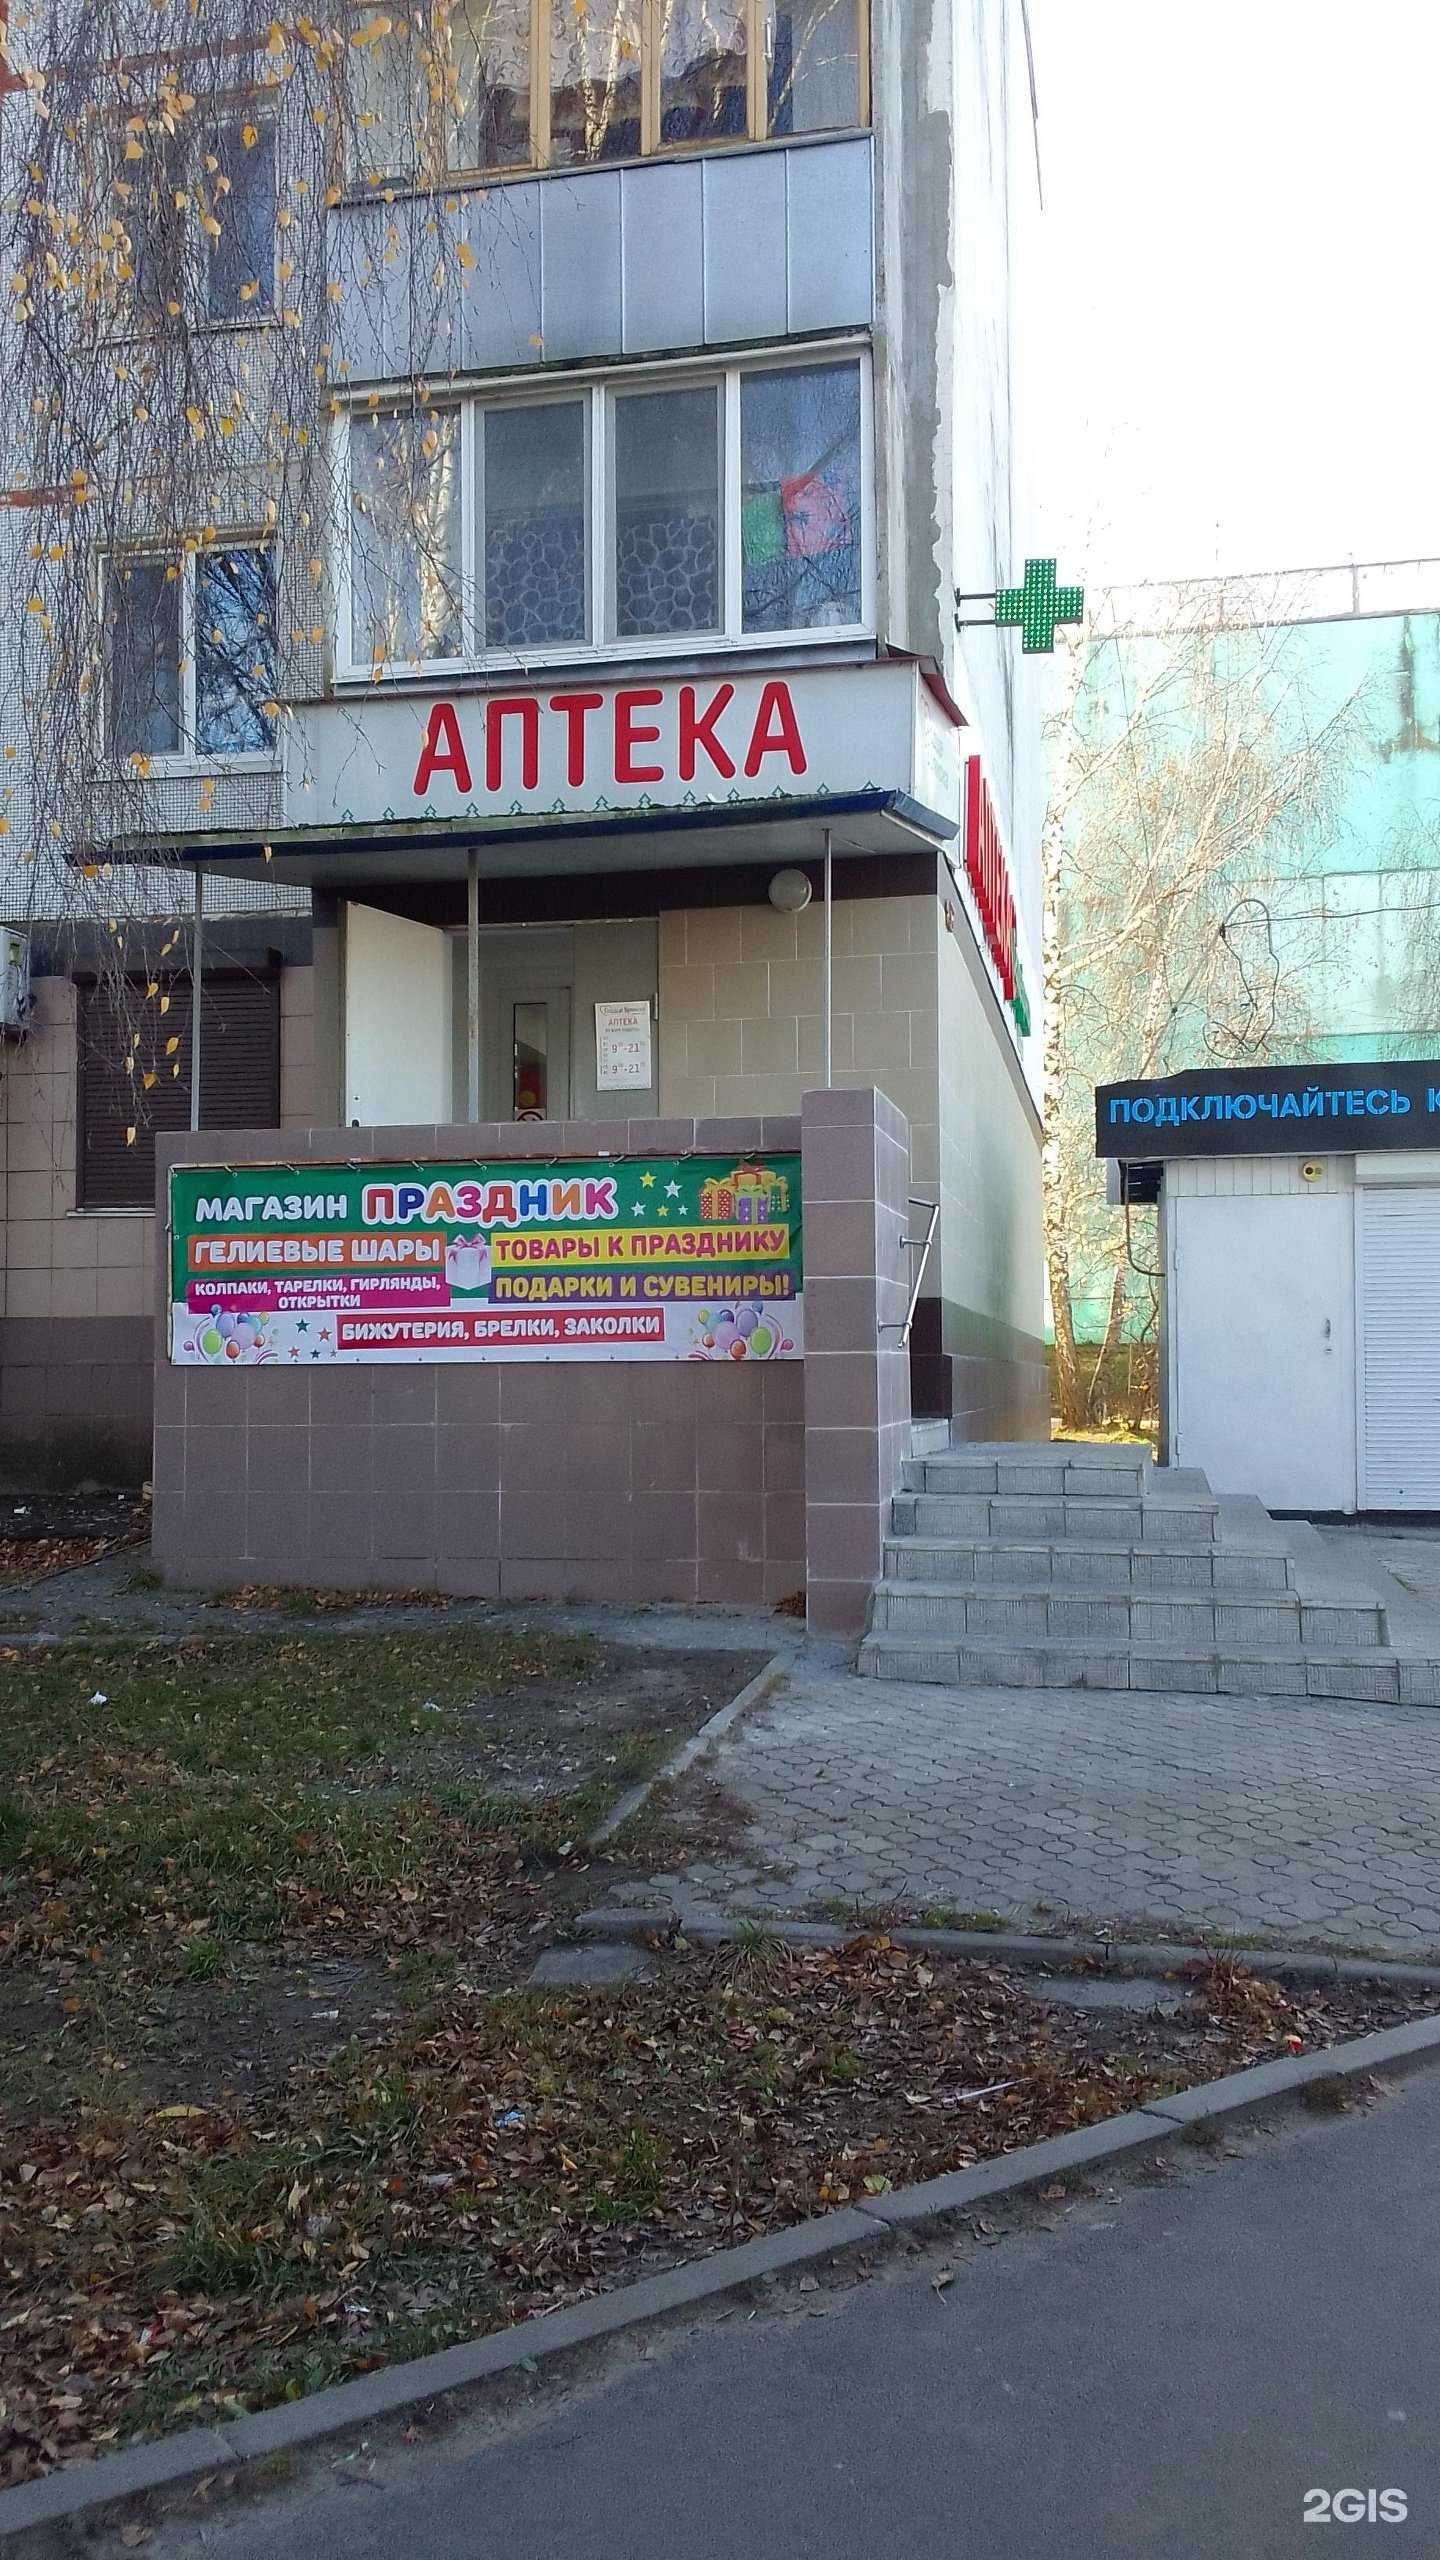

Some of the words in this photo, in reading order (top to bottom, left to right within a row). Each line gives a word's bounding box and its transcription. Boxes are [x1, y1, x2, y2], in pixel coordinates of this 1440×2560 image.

[413, 681, 808, 796] АПТЕКА
[1109, 1086, 1411, 1127] ПОДКЛЮЧАЙТЕСЬ
[195, 1194, 348, 1223] МАГАЗИН
[361, 1178, 618, 1229] ПРАЗДНИК
[194, 1239, 345, 1264] ГЕЛИЕВЫЕ
[351, 1238, 440, 1262] ШАРЫ
[495, 1236, 600, 1261] ТОВАРЫ
[608, 1235, 624, 1257] К
[631, 1229, 786, 1257] ПРАЗДНИКУ
[195, 1279, 272, 1296] КОЛПАКИ,
[274, 1278, 347, 1295] ТАРЕЛКИ,
[351, 1276, 441, 1293] ГИРЛЯНДЫ,
[495, 1276, 613, 1301] ПОДАРКИ
[620, 1276, 636, 1296] И
[643, 1274, 790, 1297] СУВЕНИРЫ!
[277, 1294, 361, 1309] ОТКРЫТКИ
[342, 1320, 470, 1341] БИЖУТЕРИЯ,
[474, 1319, 560, 1338] БРЕЛКИ,
[563, 1316, 660, 1334] ЗАКОЛКИ
